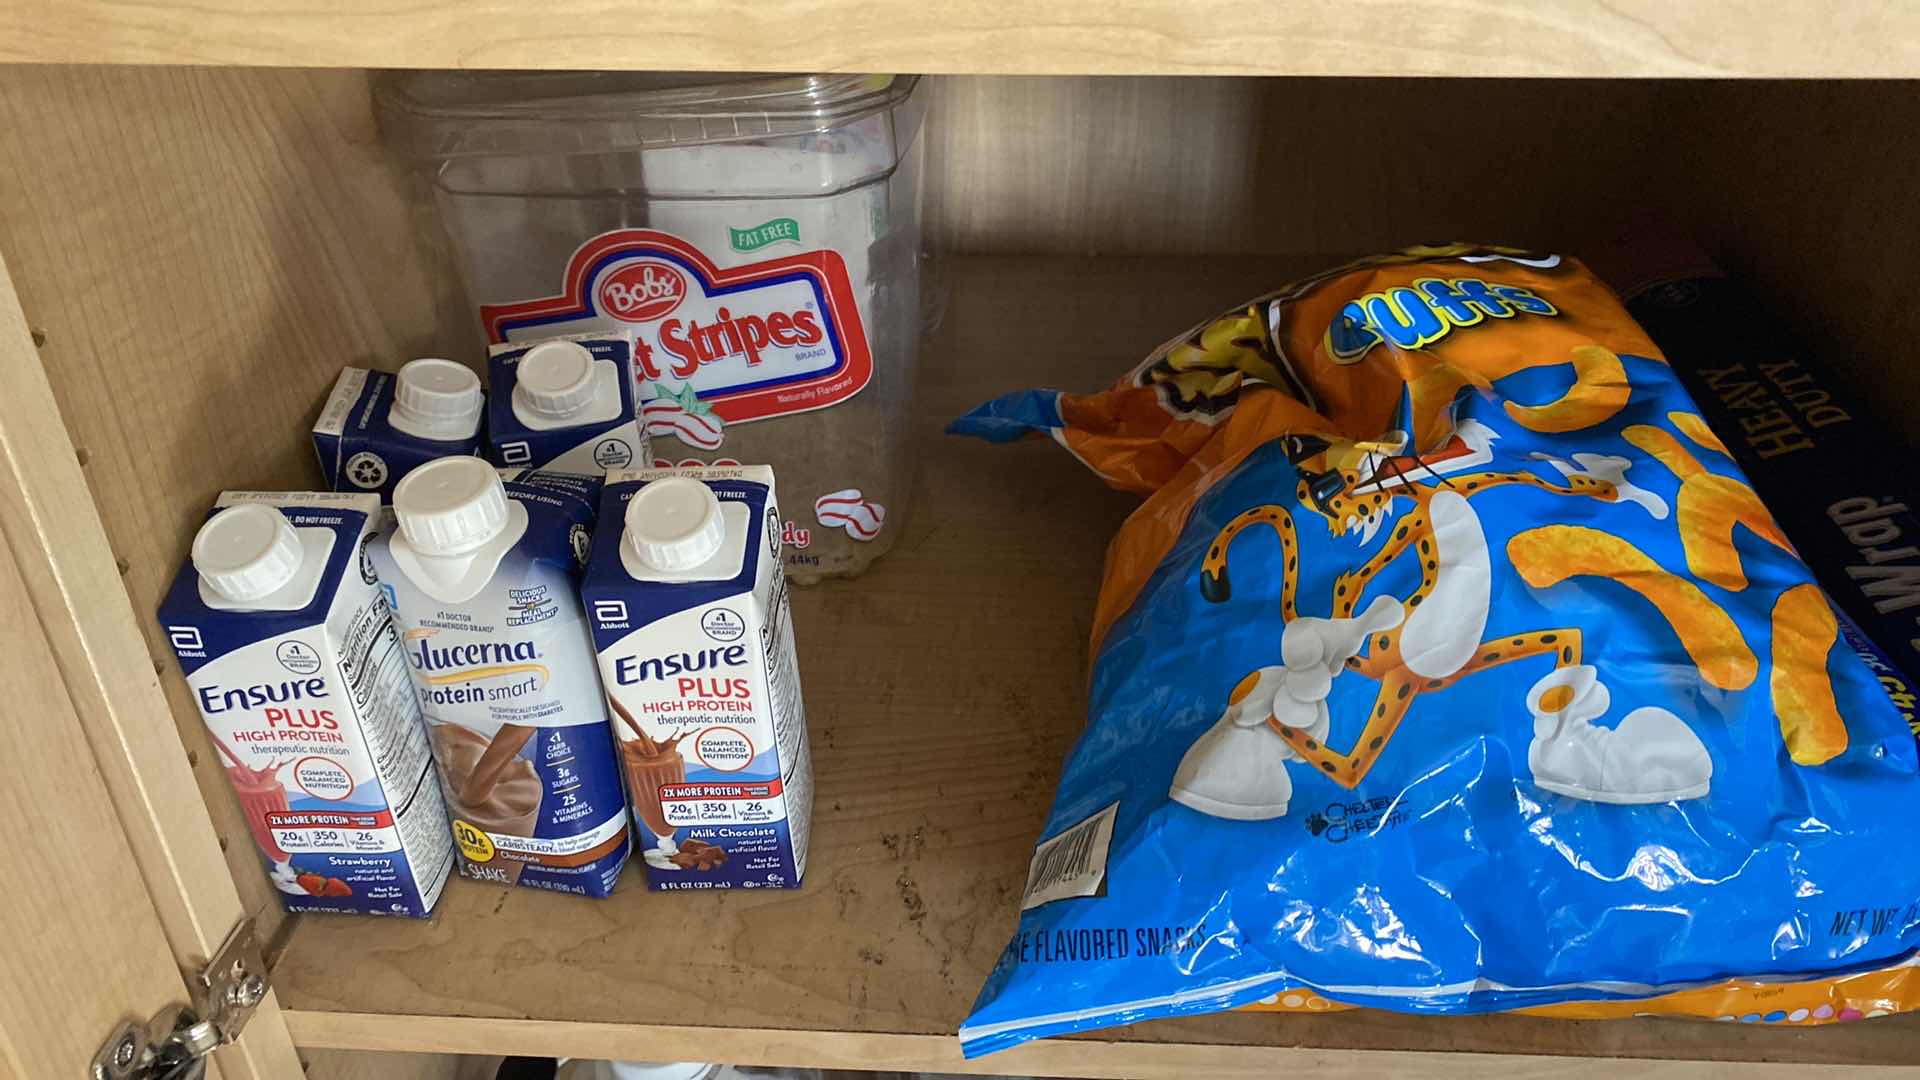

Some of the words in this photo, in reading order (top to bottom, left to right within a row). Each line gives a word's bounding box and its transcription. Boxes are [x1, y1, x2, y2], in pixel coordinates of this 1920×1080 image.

[737, 230, 759, 248] FAT
[761, 222, 793, 242] FREE
[659, 306, 824, 381] Stripes
[795, 347, 827, 362] BRAND
[777, 388, 816, 403] Naturally
[816, 377, 854, 396] Flavored
[1757, 359, 1852, 430] DUTY
[1696, 360, 1817, 461] HEAVY
[1826, 496, 1920, 615] Wrap
[445, 613, 472, 622] DOCTOR
[615, 645, 749, 686] Ensure
[421, 682, 485, 706] protein
[488, 677, 538, 701] smart
[678, 678, 751, 699] PLUS
[199, 678, 330, 714] Ensure
[643, 701, 684, 713] HIGH
[687, 700, 753, 712] PROTEIN
[265, 708, 339, 730] PLUS
[657, 714, 713, 726] therapeutic
[714, 713, 756, 724] nutrition
[233, 730, 276, 743] HIGH
[279, 730, 344, 743] PROTEIN
[549, 731, 562, 744] <1
[251, 745, 308, 756] therapeutic
[308, 745, 351, 756] nutrition
[546, 746, 572, 760] CHOICE
[547, 742, 566, 752] CARB
[302, 775, 346, 783] BALANCED
[552, 775, 579, 789] SUGARS
[663, 787, 676, 798] 2X
[677, 786, 703, 798] MORE
[703, 786, 742, 797] PROTEIN
[562, 793, 577, 806] 25
[554, 801, 589, 816] VITAMINS
[703, 802, 727, 813] 350
[746, 802, 763, 811] 26
[270, 815, 283, 826] 2X
[284, 814, 311, 826] MORE
[311, 814, 350, 825] PROTEIN
[558, 806, 593, 823] MINERALS
[668, 813, 696, 821] Protein
[700, 812, 732, 821] Calories
[312, 831, 338, 841] 350
[356, 831, 373, 841] 26
[690, 828, 717, 838] Milk
[718, 827, 776, 838] Chocolate
[763, 837, 777, 845] and
[728, 845, 757, 853] artificial
[757, 844, 778, 852] flavor
[329, 856, 392, 868] Strawberry
[468, 863, 511, 884] SHAKE
[668, 882, 679, 890] FL
[1829, 908, 1868, 936] NET
[1035, 928, 1129, 963] FLAVORED
